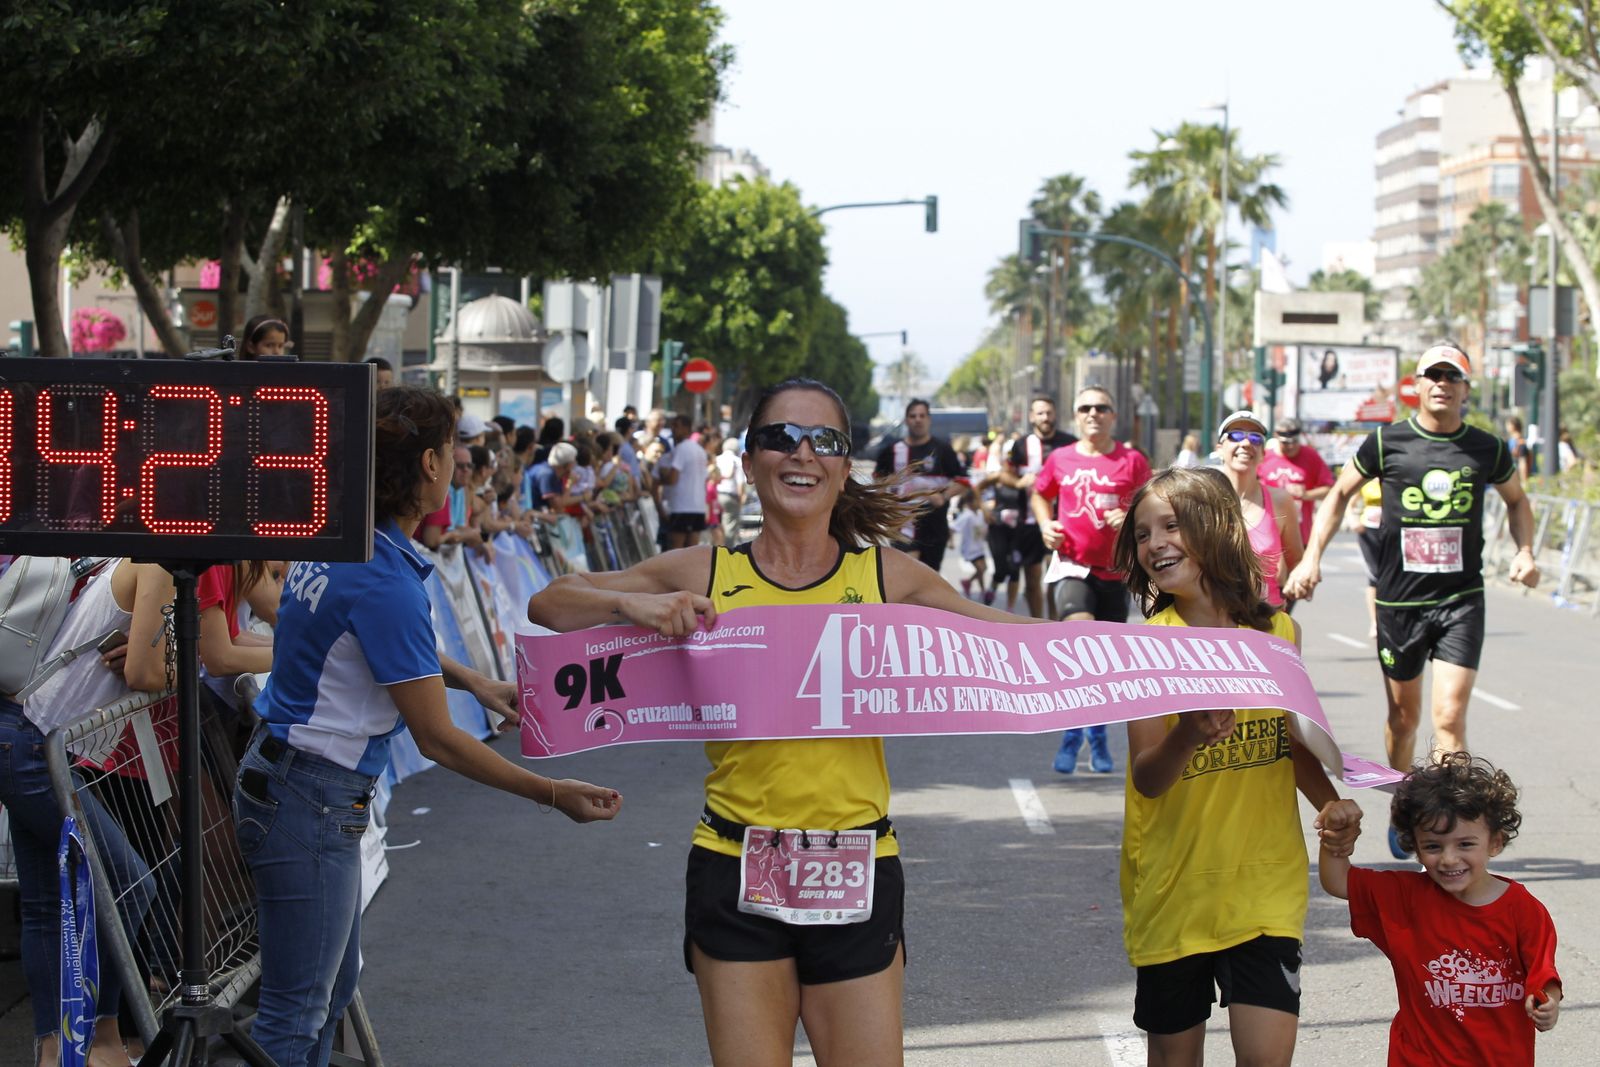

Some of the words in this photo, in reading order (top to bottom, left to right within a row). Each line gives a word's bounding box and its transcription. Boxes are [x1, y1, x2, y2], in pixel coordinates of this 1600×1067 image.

[1422, 541, 1458, 555] 1190
[554, 653, 627, 711] 9K
[796, 613, 861, 730] 4
[848, 624, 1050, 686] CARRERA
[1046, 634, 1272, 682] SOLIDARIA
[852, 687, 900, 715] POR
[906, 686, 948, 714] LAS
[952, 686, 1107, 716] ENFERMEDADES
[1110, 677, 1162, 704] POCO
[1162, 676, 1284, 698] FRECUENTES
[784, 860, 865, 888] 1283
[798, 888, 825, 899] SÚPER
[826, 890, 846, 900] PAU
[1428, 953, 1470, 978] ego
[1424, 979, 1525, 1007] WEEKEND
